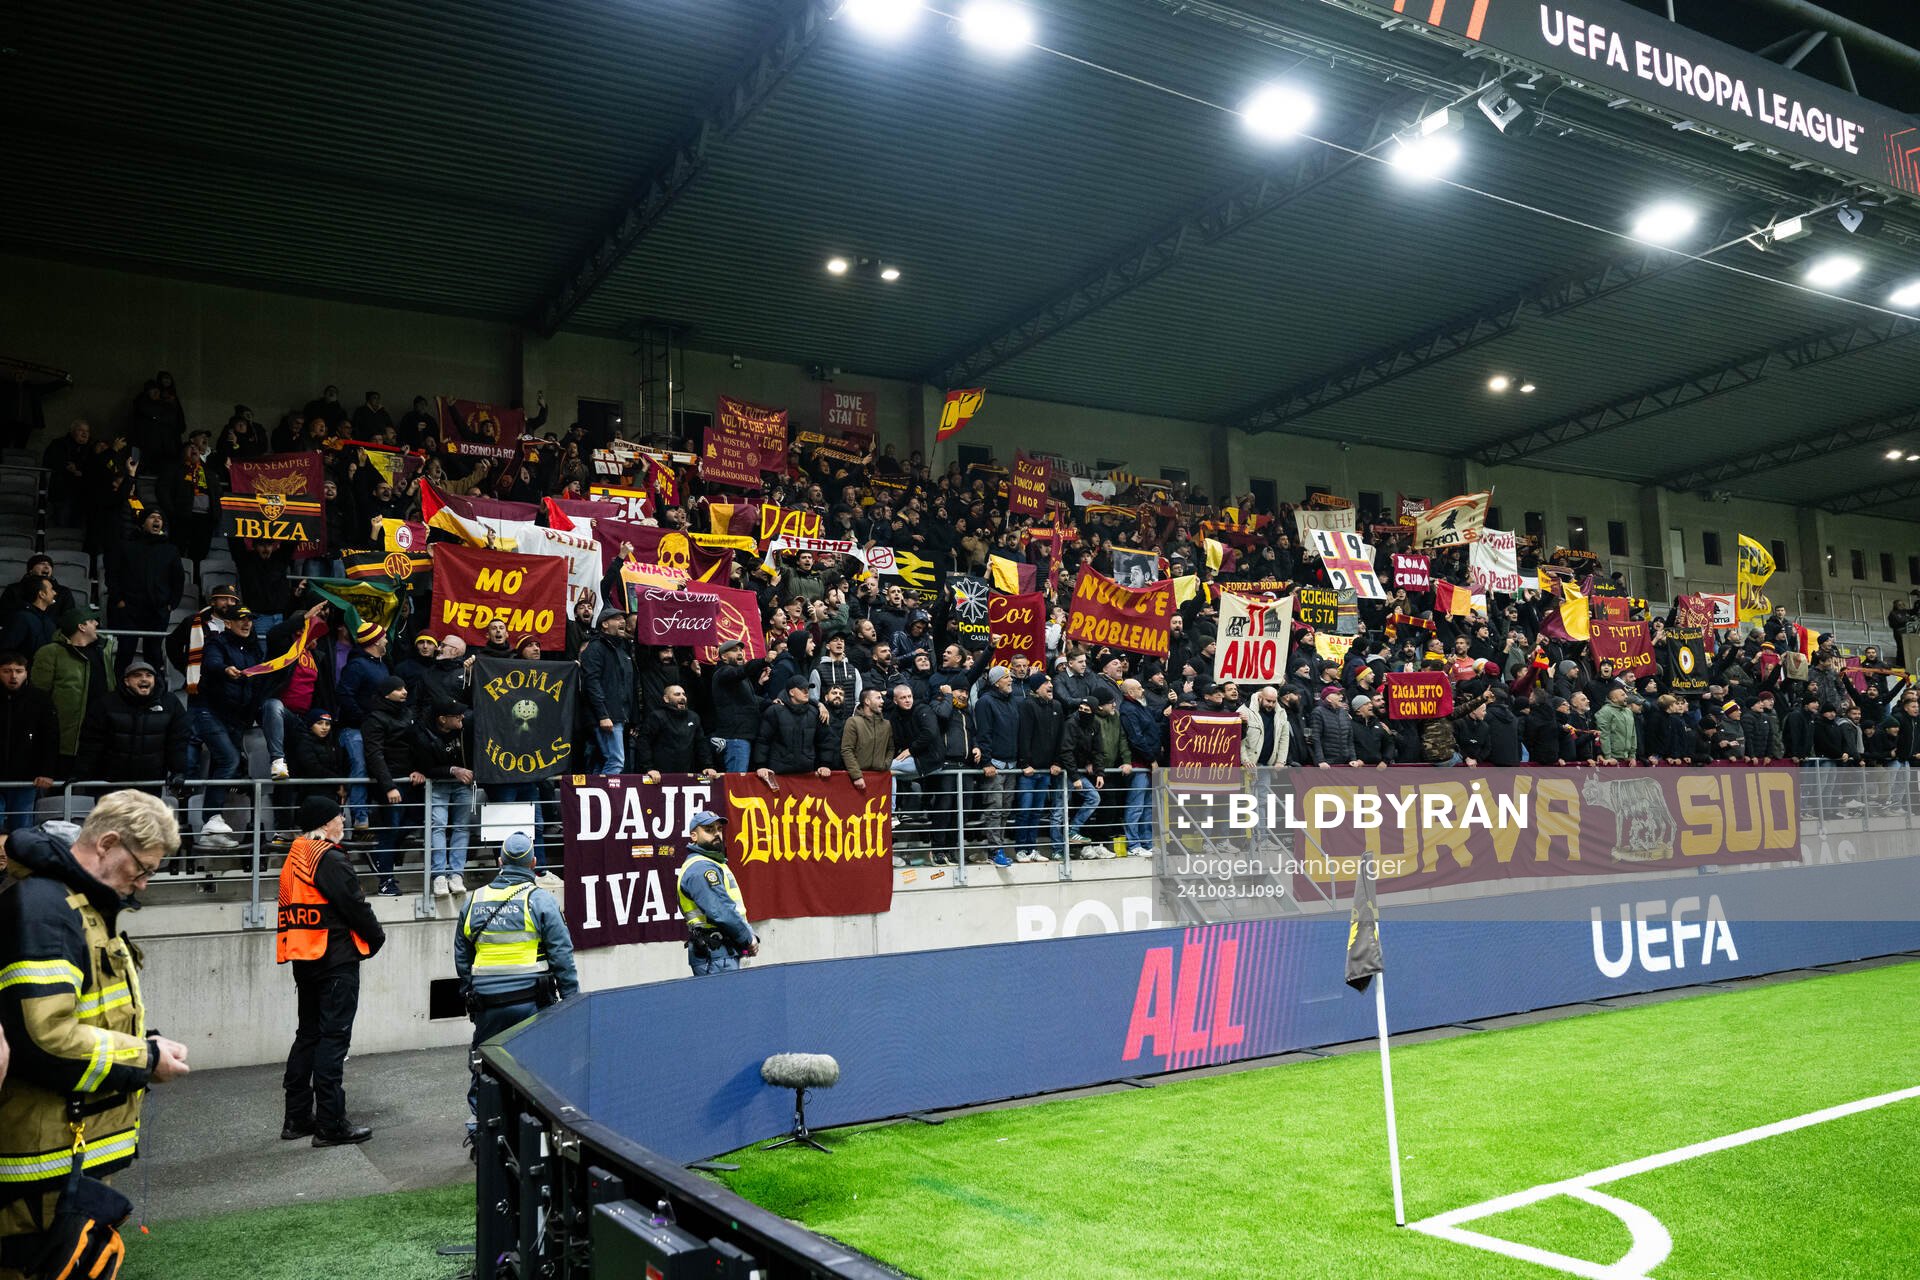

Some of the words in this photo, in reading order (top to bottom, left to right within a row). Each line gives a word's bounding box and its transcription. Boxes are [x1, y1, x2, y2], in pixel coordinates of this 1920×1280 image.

[1539, 3, 1630, 72] UEFA
[1635, 40, 1753, 118] EUROPA
[834, 393, 862, 411] DOVE
[828, 408, 852, 425] STAI
[265, 458, 311, 471] SEMPRE
[723, 448, 742, 458] FEDE
[1016, 494, 1038, 509] AMOR
[234, 517, 309, 542] IBIZA
[781, 535, 801, 549] TI
[807, 539, 853, 553] AMO
[1397, 555, 1428, 571] ROMA
[1077, 574, 1132, 611] NUN
[1225, 581, 1253, 591] FORZA
[1260, 581, 1284, 590] ROMA
[1395, 572, 1430, 587] CRUDA
[1488, 570, 1517, 591] Party
[442, 600, 555, 634] VEDEMO
[652, 609, 713, 636] Facce
[989, 596, 1034, 625] Cor
[1245, 603, 1271, 637] TI
[996, 633, 1034, 650] ore
[1067, 611, 1170, 654] PROBLEMA
[1329, 636, 1353, 646] DAJE
[1609, 625, 1642, 638] TUTTI
[1219, 639, 1277, 681] AMO
[483, 669, 564, 702] ROMA
[1391, 684, 1443, 699] ZAGAJETTO
[1399, 701, 1418, 716] CON
[1420, 701, 1437, 715] NOI
[1172, 714, 1237, 755] Emilio
[485, 736, 571, 773] HOOLS
[1176, 760, 1202, 779] con
[1208, 754, 1235, 780] noi
[575, 785, 711, 841] DAJE
[729, 788, 888, 866] Diffidati
[1304, 774, 1581, 884] CURVA
[1676, 772, 1796, 857] SUD
[580, 868, 684, 930] IVA
[1590, 894, 1739, 979] UEFA
[1121, 939, 1245, 1061] ALL
